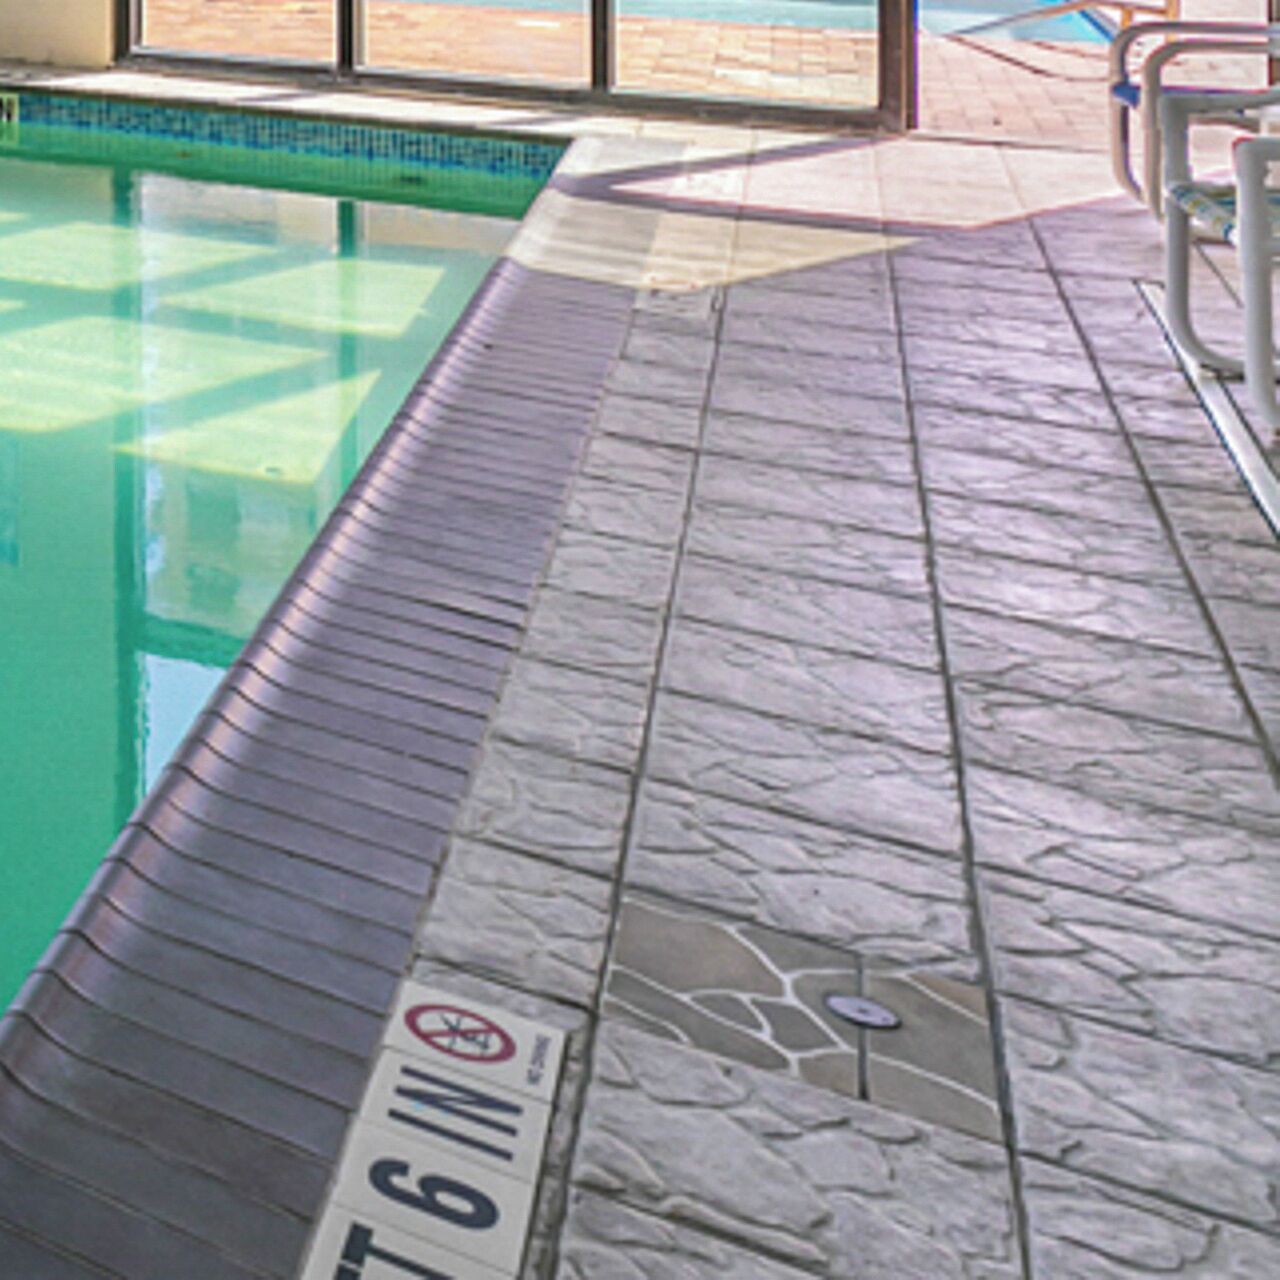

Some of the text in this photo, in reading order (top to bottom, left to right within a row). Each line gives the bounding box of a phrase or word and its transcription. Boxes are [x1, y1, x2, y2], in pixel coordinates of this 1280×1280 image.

[333, 1064, 524, 1280] T 6 IN
